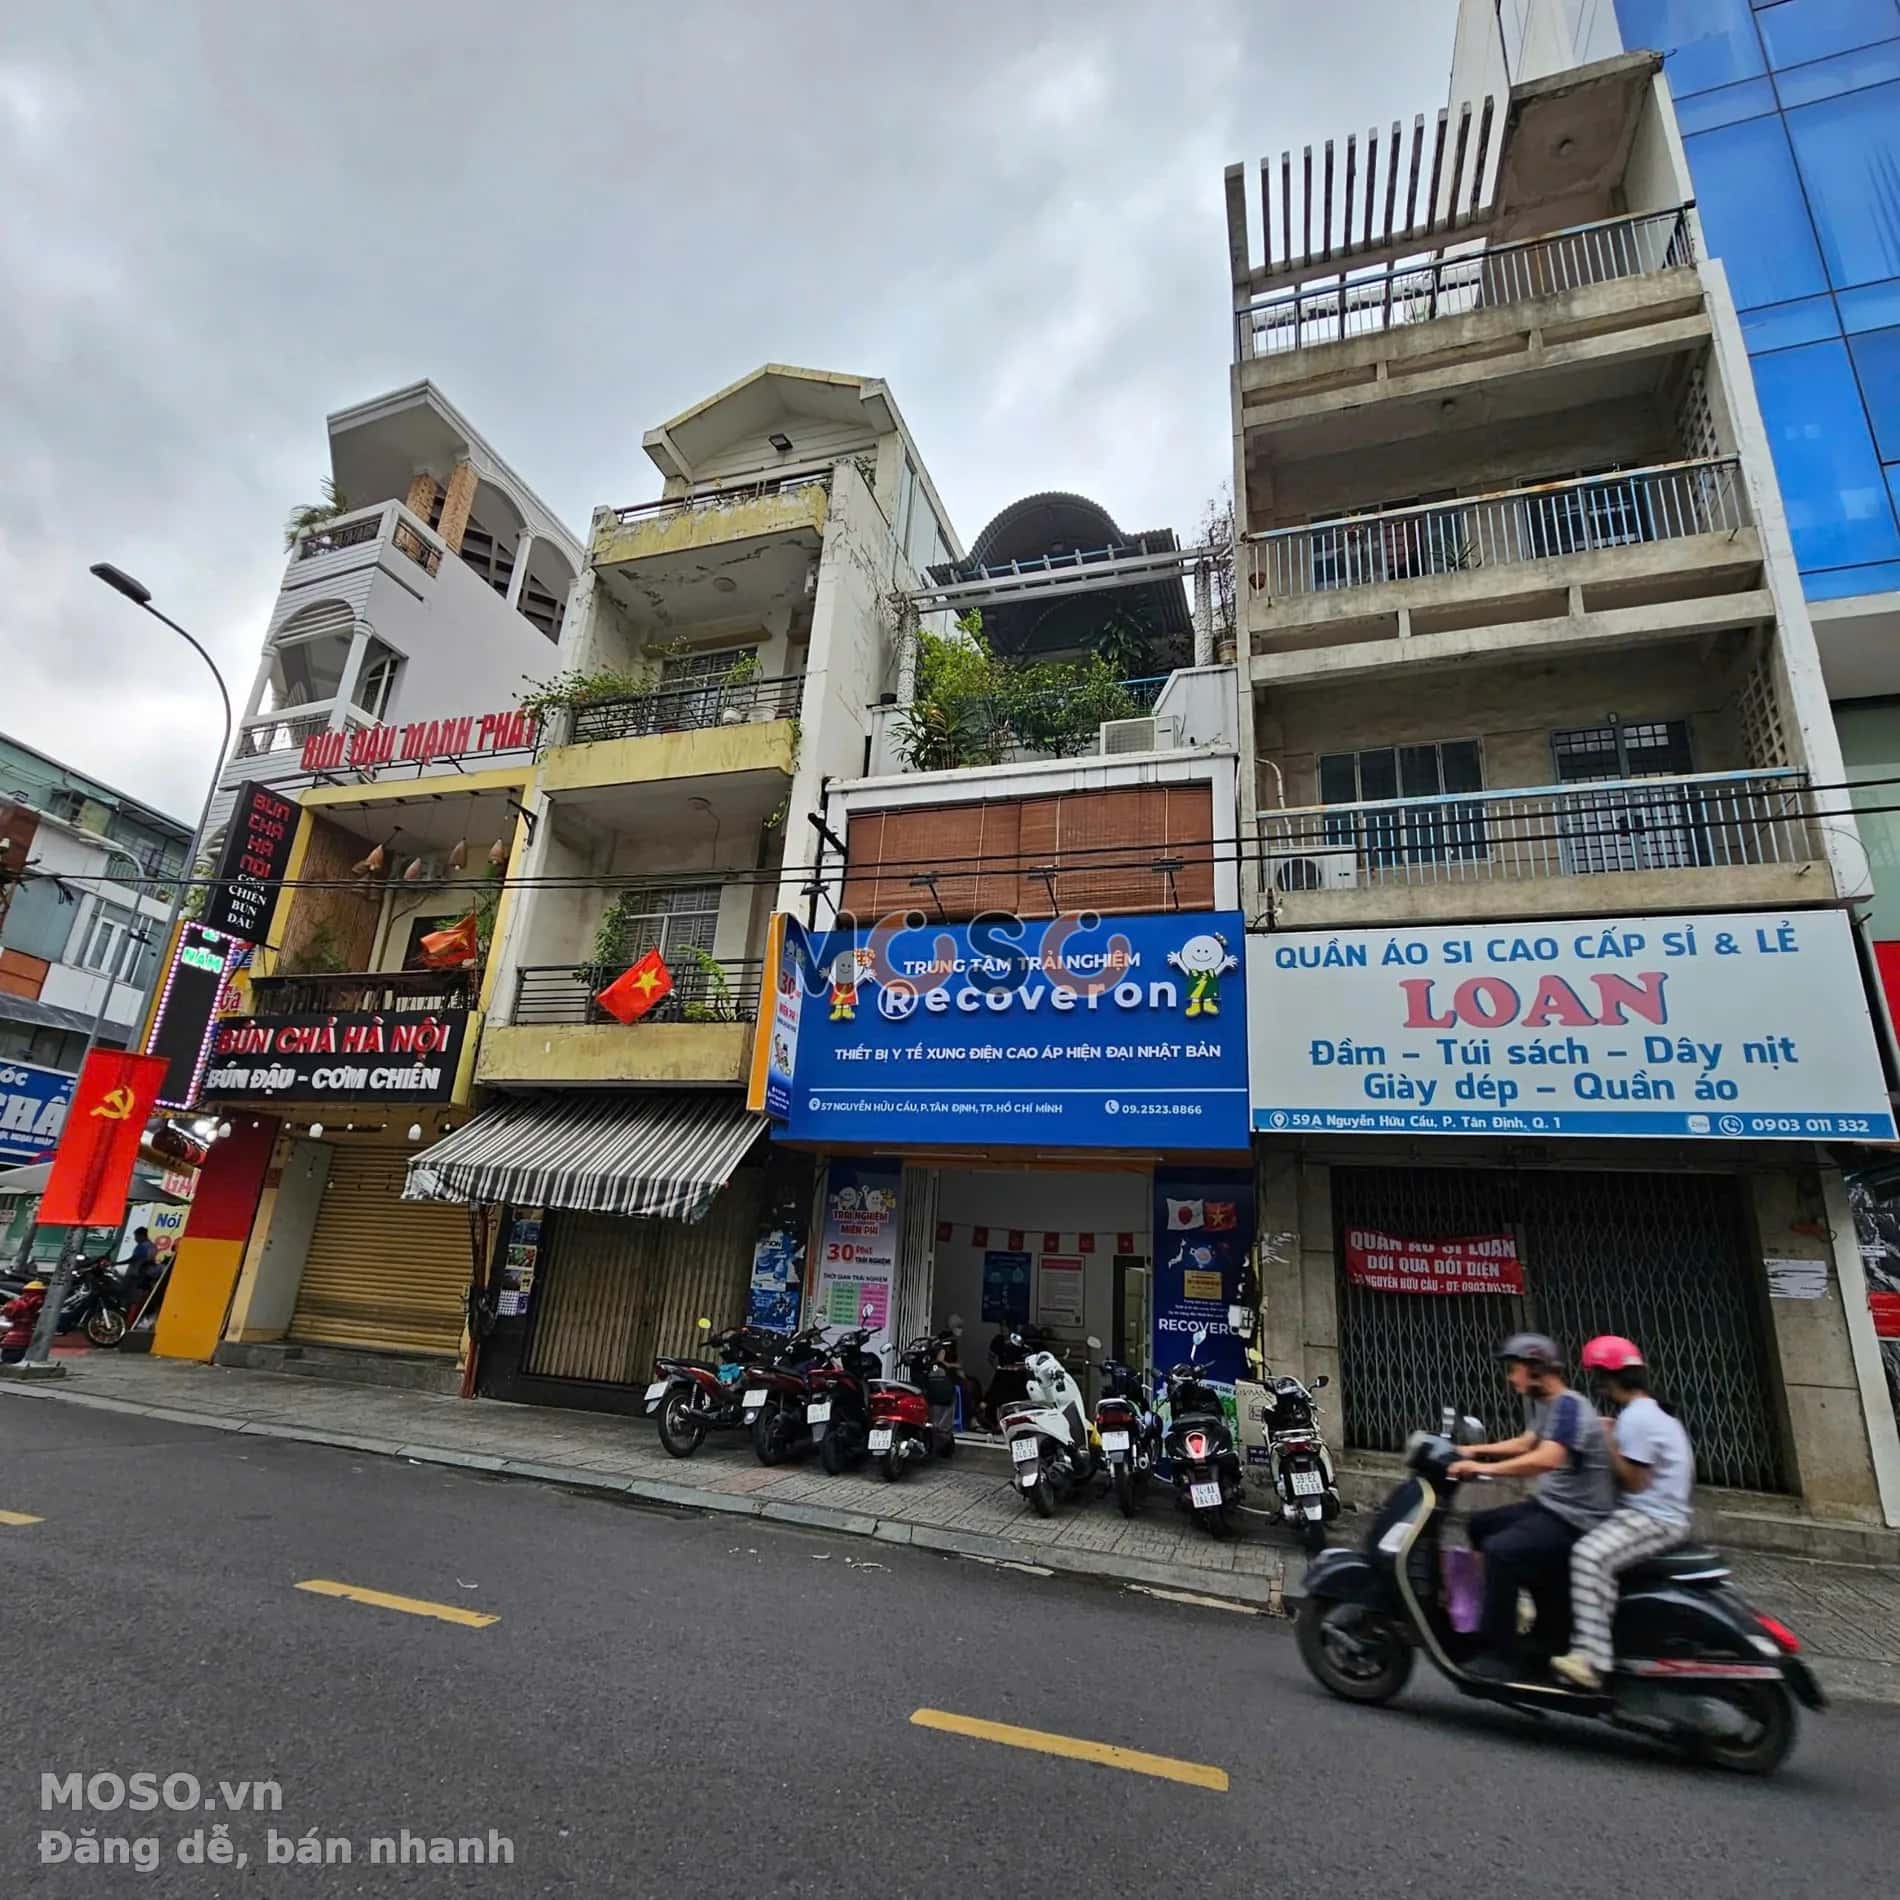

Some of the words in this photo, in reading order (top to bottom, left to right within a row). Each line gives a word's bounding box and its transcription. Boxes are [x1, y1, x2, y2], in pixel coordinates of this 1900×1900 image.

[300, 727, 347, 770] BÚN
[400, 716, 474, 767] MẠNH
[1275, 937, 1367, 969] QUẦN
[1381, 937, 1429, 966] ÁO
[1442, 940, 1473, 964] SI
[1487, 937, 1559, 963] CAO
[1574, 925, 1646, 959] CẤP
[1662, 923, 1698, 957] SỈ
[1714, 932, 1742, 955] &
[1756, 919, 1800, 953] LẺ
[903, 957, 966, 975] TRUNG
[970, 953, 1012, 972] TÂM
[1018, 950, 1064, 972] TRẢI
[1067, 949, 1142, 971] NGHIỆM
[1399, 972, 1669, 1030] LOAN
[217, 1019, 274, 1054] BÚN
[276, 1016, 337, 1054] CHẢ
[342, 1015, 385, 1054] HÀ
[390, 1016, 451, 1061] NỘI
[835, 1043, 873, 1061] THIẾT
[875, 1048, 889, 1063] BỊ
[892, 1048, 902, 1060] Y
[905, 1042, 924, 1060] TẾ
[927, 1047, 966, 1060] XUNG
[969, 1044, 1003, 1062] ĐIỆN
[1006, 1047, 1038, 1060] CAO
[1042, 1044, 1063, 1059] ÁP
[1066, 1043, 1101, 1062] HIỆN
[1106, 1045, 1133, 1062] ĐẠI
[1138, 1042, 1181, 1061] NHẬT
[1185, 1040, 1221, 1058] BẢN
[1309, 1037, 1386, 1065] Đầm
[1436, 1038, 1491, 1065] Túi
[1507, 1037, 1589, 1065] sách
[1644, 1035, 1723, 1071] Dây
[1742, 1035, 1799, 1070] nịt
[206, 1060, 250, 1089] BÚN
[250, 1062, 296, 1095] ĐẬU
[311, 1064, 367, 1089] CƠM
[369, 1061, 441, 1090] CHIÊN
[1364, 1072, 1438, 1106] Giày
[1455, 1071, 1519, 1108] dép
[1573, 1069, 1675, 1101] Quần
[1694, 1072, 1738, 1101] áo
[1122, 1104, 1203, 1115] 09.2523.8866
[1292, 1114, 1322, 1126] 59A
[1442, 1115, 1456, 1128] P.
[1461, 1116, 1487, 1129] Tân
[1532, 1117, 1549, 1129] Q.
[1553, 1117, 1561, 1129] 1
[1751, 1118, 1800, 1132] 0903
[1806, 1118, 1832, 1132] 011
[1838, 1119, 1870, 1133] 332
[827, 1243, 855, 1262] 30
[1399, 1256, 1430, 1274] QUA
